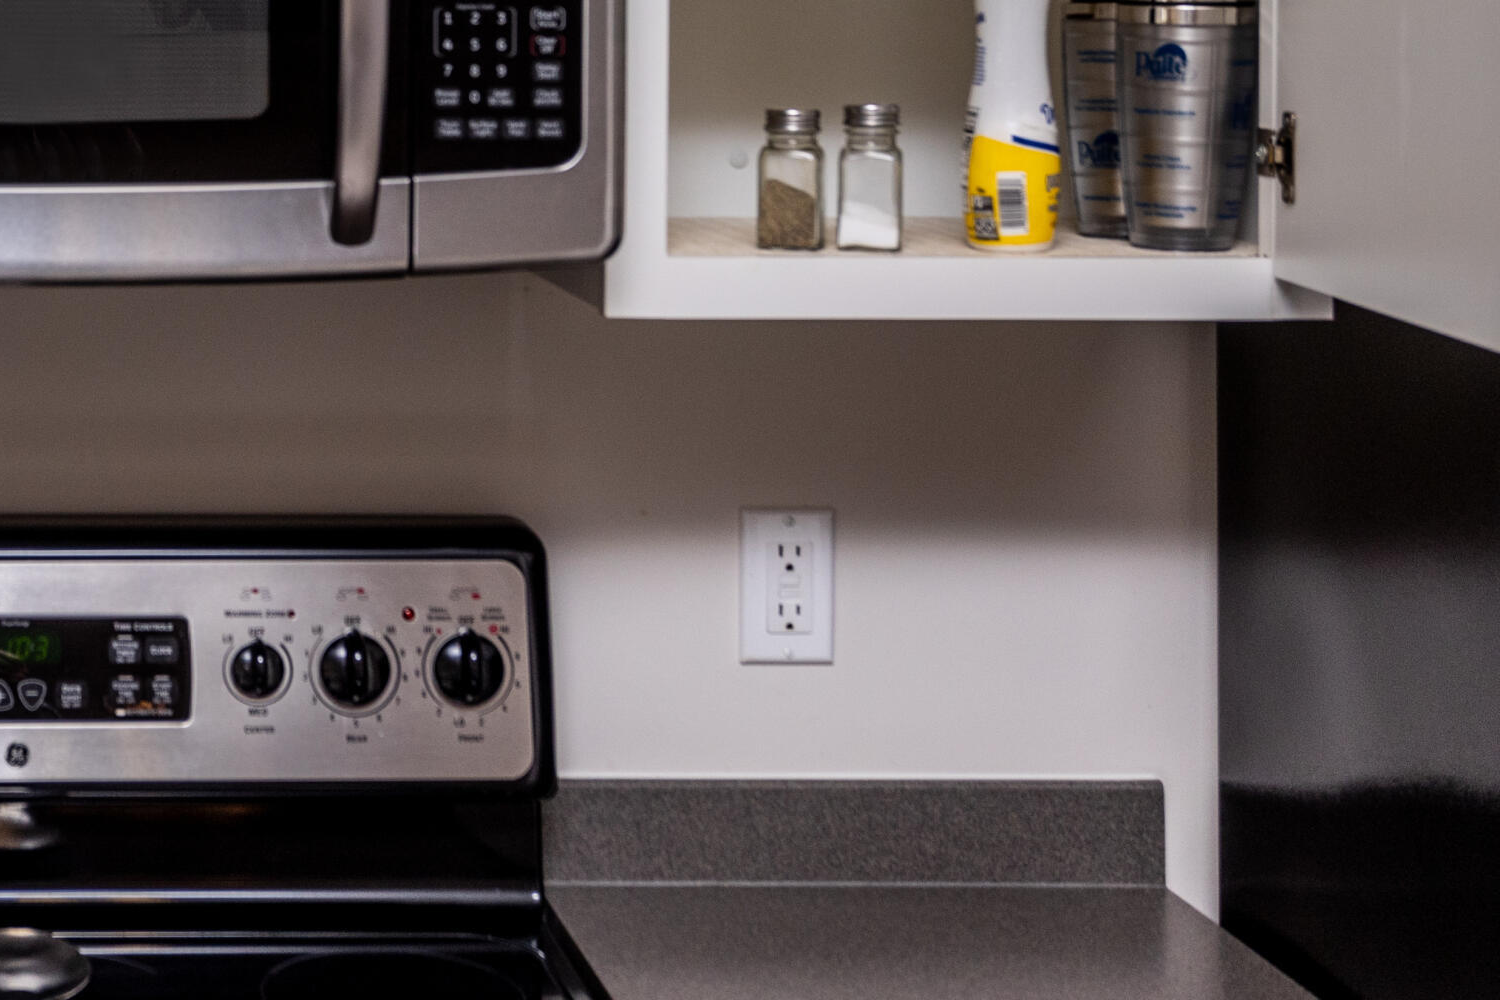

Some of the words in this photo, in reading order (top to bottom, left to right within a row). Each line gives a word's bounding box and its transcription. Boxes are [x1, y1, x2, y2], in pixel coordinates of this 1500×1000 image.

[443, 11, 452, 25] 1
[469, 11, 481, 25] 2
[496, 11, 507, 25] 3
[442, 38, 453, 51] 4
[469, 38, 480, 51] 5
[496, 38, 507, 51] 6
[443, 64, 453, 77] 7
[469, 64, 481, 78] 8
[496, 64, 507, 78] 9
